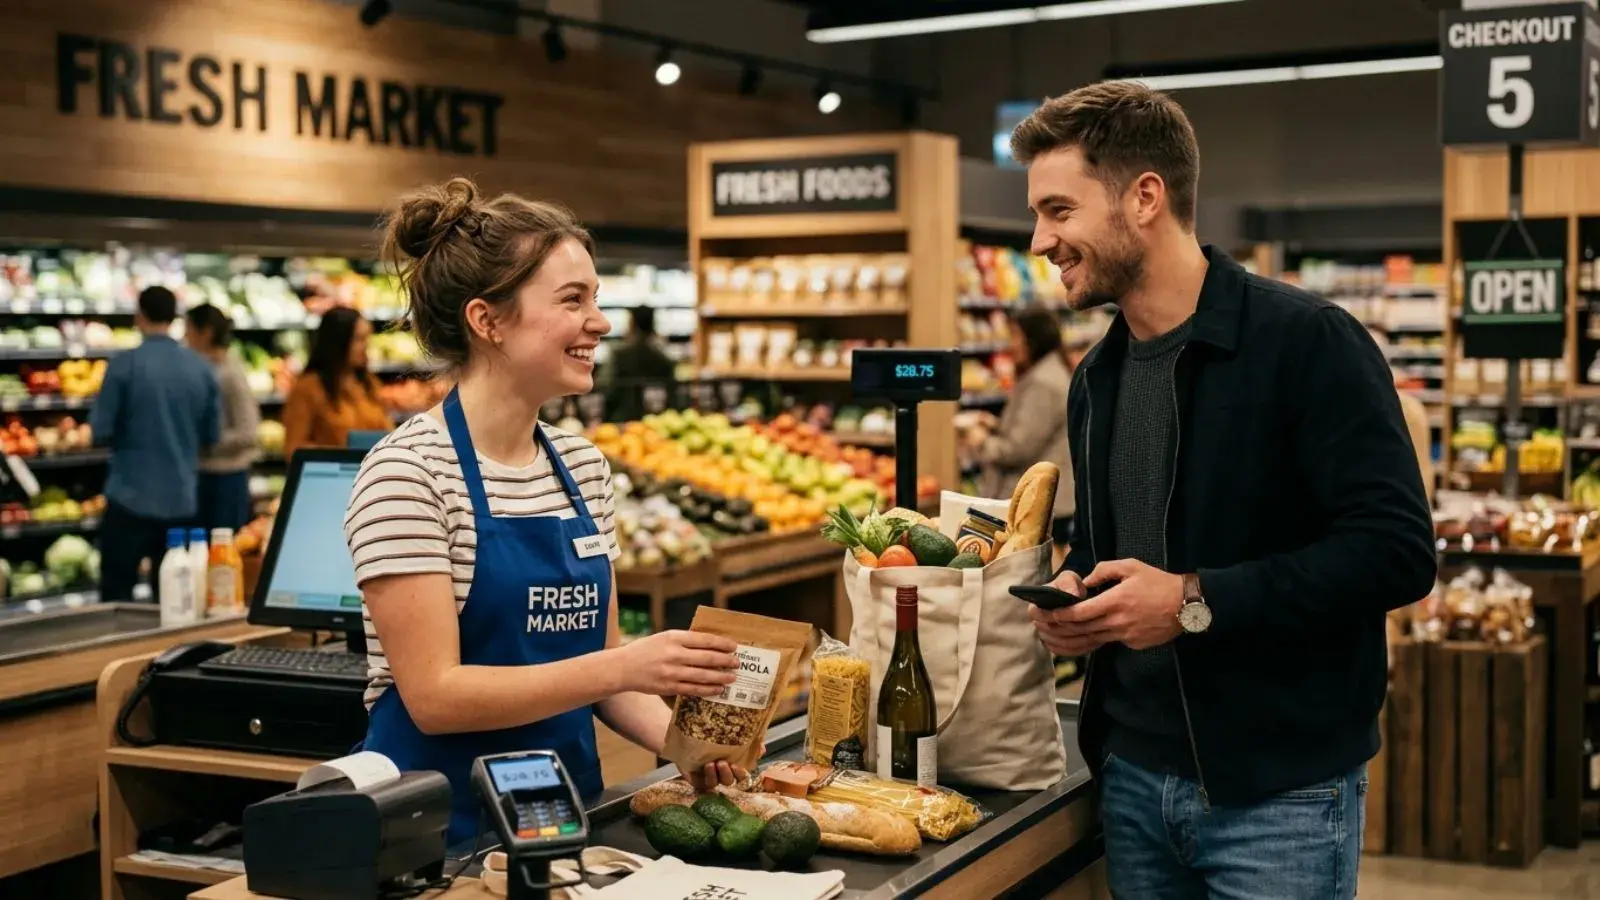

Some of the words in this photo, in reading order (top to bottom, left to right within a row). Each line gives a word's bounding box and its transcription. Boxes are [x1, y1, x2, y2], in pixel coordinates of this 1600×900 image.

[1448, 15, 1577, 48] CHECKOUT
[56, 33, 268, 132] FRESH
[295, 70, 505, 157] MARKET
[1486, 55, 1535, 129] 5
[716, 169, 799, 206] FRESH
[803, 164, 891, 201] FOODS
[1470, 268, 1556, 313] OPEN
[895, 364, 934, 378] $28.75
[528, 583, 599, 610] FRESH
[526, 609, 600, 633] MARKET
[740, 661, 770, 675] NOLA
